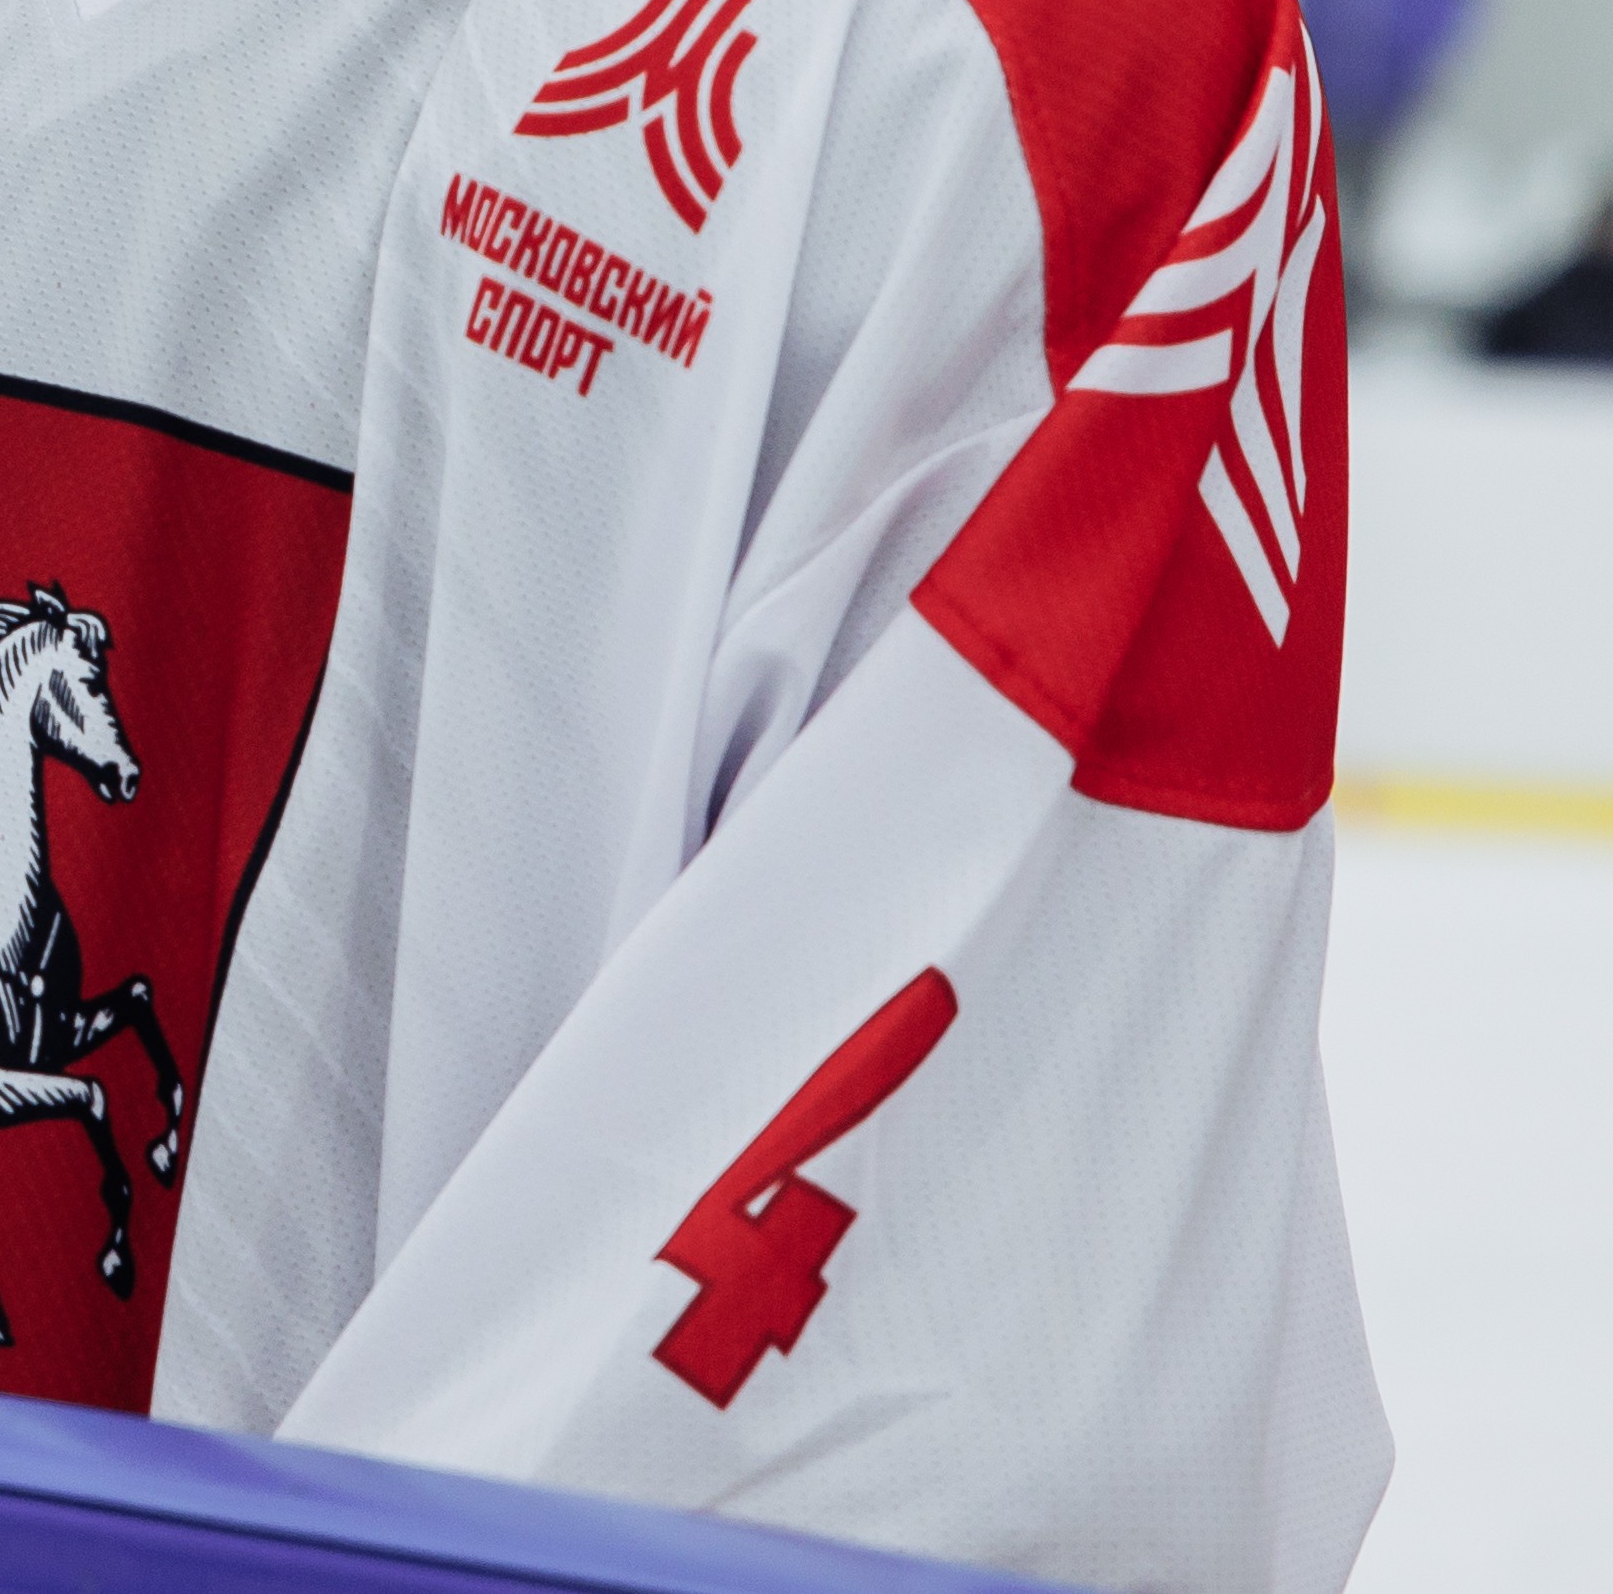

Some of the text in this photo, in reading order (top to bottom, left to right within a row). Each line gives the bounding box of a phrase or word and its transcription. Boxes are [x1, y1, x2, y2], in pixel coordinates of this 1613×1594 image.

[440, 172, 714, 369] МОСКОВСКИЙ
[466, 274, 615, 397] СПОРТ
[651, 963, 959, 1411] 4
